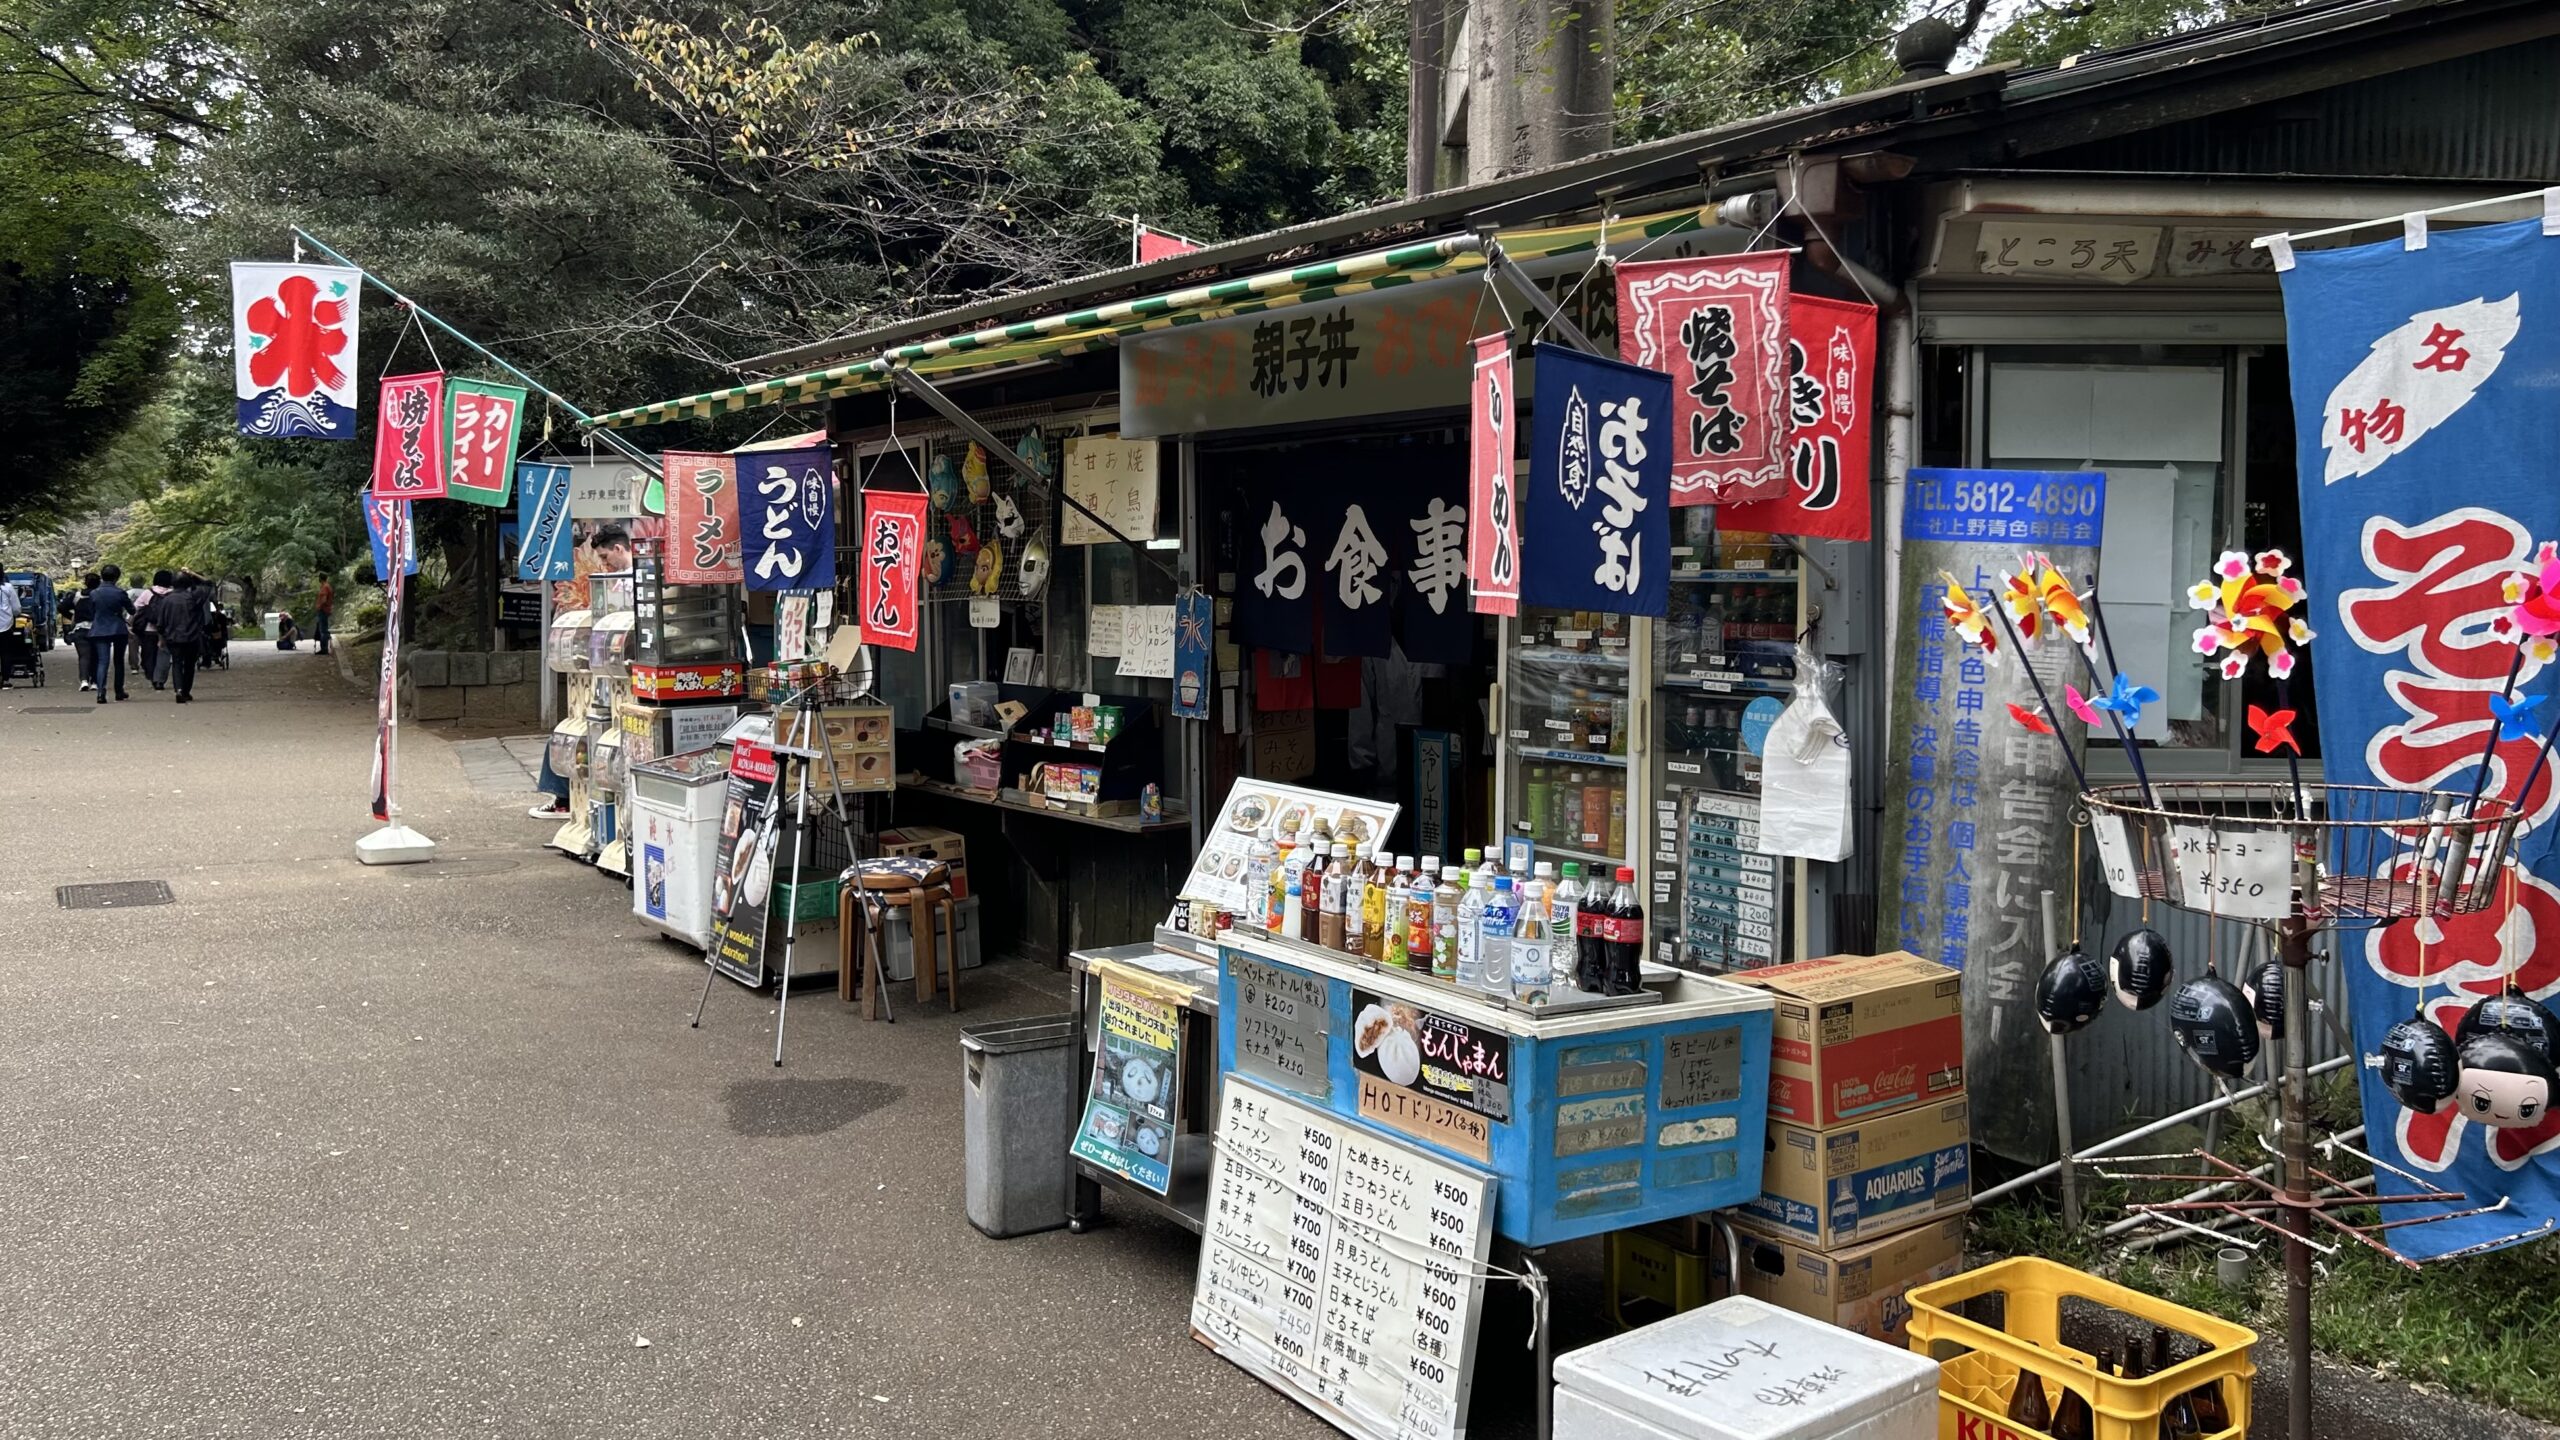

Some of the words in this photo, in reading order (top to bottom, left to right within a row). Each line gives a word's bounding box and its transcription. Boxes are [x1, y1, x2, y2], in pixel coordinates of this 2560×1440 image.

[1997, 237, 2139, 275] ところ天
[1250, 304, 1360, 398] 親子丼
[1832, 344, 1851, 416] 味自慢
[1682, 305, 1748, 457] 焼そば
[2340, 322, 2471, 455] 名物
[393, 385, 430, 489] 焼そば
[452, 401, 477, 482] ライス
[483, 402, 509, 477] カレー
[525, 473, 568, 574] ところてん
[693, 467, 726, 571] ラーメン
[754, 466, 803, 579] うどん
[806, 476, 821, 518] 味自慢
[1954, 481, 2096, 517] 5812-4890
[871, 519, 902, 627] おでん
[1254, 498, 1468, 615] お食事
[1422, 745, 1440, 849] 冷し中華
[1692, 849, 1739, 863] 炭焼コーヒー
[1698, 866, 1721, 878] 甘酒
[2200, 870, 2264, 897] ¥350
[1691, 882, 1738, 898] ところ天
[1692, 898, 1738, 914] ラムネ
[1264, 993, 1294, 1016] ¥200
[1246, 1039, 1270, 1056] モナカ
[1278, 1054, 1304, 1077] ¥250
[1421, 1027, 1504, 1080] もんじゃまん
[1874, 1064, 1917, 1094] Coca-Cola
[1231, 1096, 1269, 1121] 焼そば
[1304, 1125, 1332, 1150] ¥500
[1231, 1116, 1270, 1143] ラーメン
[1301, 1147, 1329, 1170] ¥600
[1080, 1140, 1165, 1187] ぜひ一度お試しください!
[1225, 1157, 1283, 1195] 五目ラーメン
[1296, 1194, 1324, 1216] ¥850
[1299, 1170, 1327, 1195] ¥700
[1346, 1146, 1414, 1186] たぬきうどん
[1434, 1180, 1468, 1206] ¥500
[1866, 1166, 1925, 1202] AQUARIUS
[1220, 1199, 1253, 1227] 親子丼
[1291, 1234, 1319, 1261] ¥850
[1293, 1212, 1321, 1237] ¥700
[1340, 1192, 1397, 1231] 五目うどん
[1429, 1232, 1463, 1260] ¥600
[1344, 1169, 1411, 1211] きつねうどん
[1430, 1207, 1464, 1234] ¥500
[1213, 1248, 1269, 1293] ビール(中ビン)
[1283, 1284, 1313, 1310] ¥700
[1217, 1220, 1272, 1259] カレーライス
[1287, 1257, 1316, 1284] ¥700
[1335, 1239, 1391, 1278] 月見うどん
[1423, 1283, 1456, 1311] ¥600
[1425, 1258, 1458, 1285] ¥600
[1204, 1309, 1241, 1346] ところ天
[1270, 1348, 1298, 1377] ¥400
[1207, 1290, 1240, 1321] おでん
[1274, 1331, 1304, 1358] ¥600
[1279, 1306, 1311, 1336] ¥450
[1327, 1308, 1375, 1346] ざるそば
[1410, 1355, 1444, 1384] ¥600
[1329, 1284, 1379, 1322] 日本そば
[1412, 1329, 1449, 1361] (各種)
[1416, 1306, 1449, 1335] ¥600
[1322, 1332, 1369, 1371] 炭焼珈琲
[1319, 1355, 1350, 1387] 紅茶
[1401, 1401, 1438, 1437] ¥400
[1957, 1410, 2020, 1440] KIR
